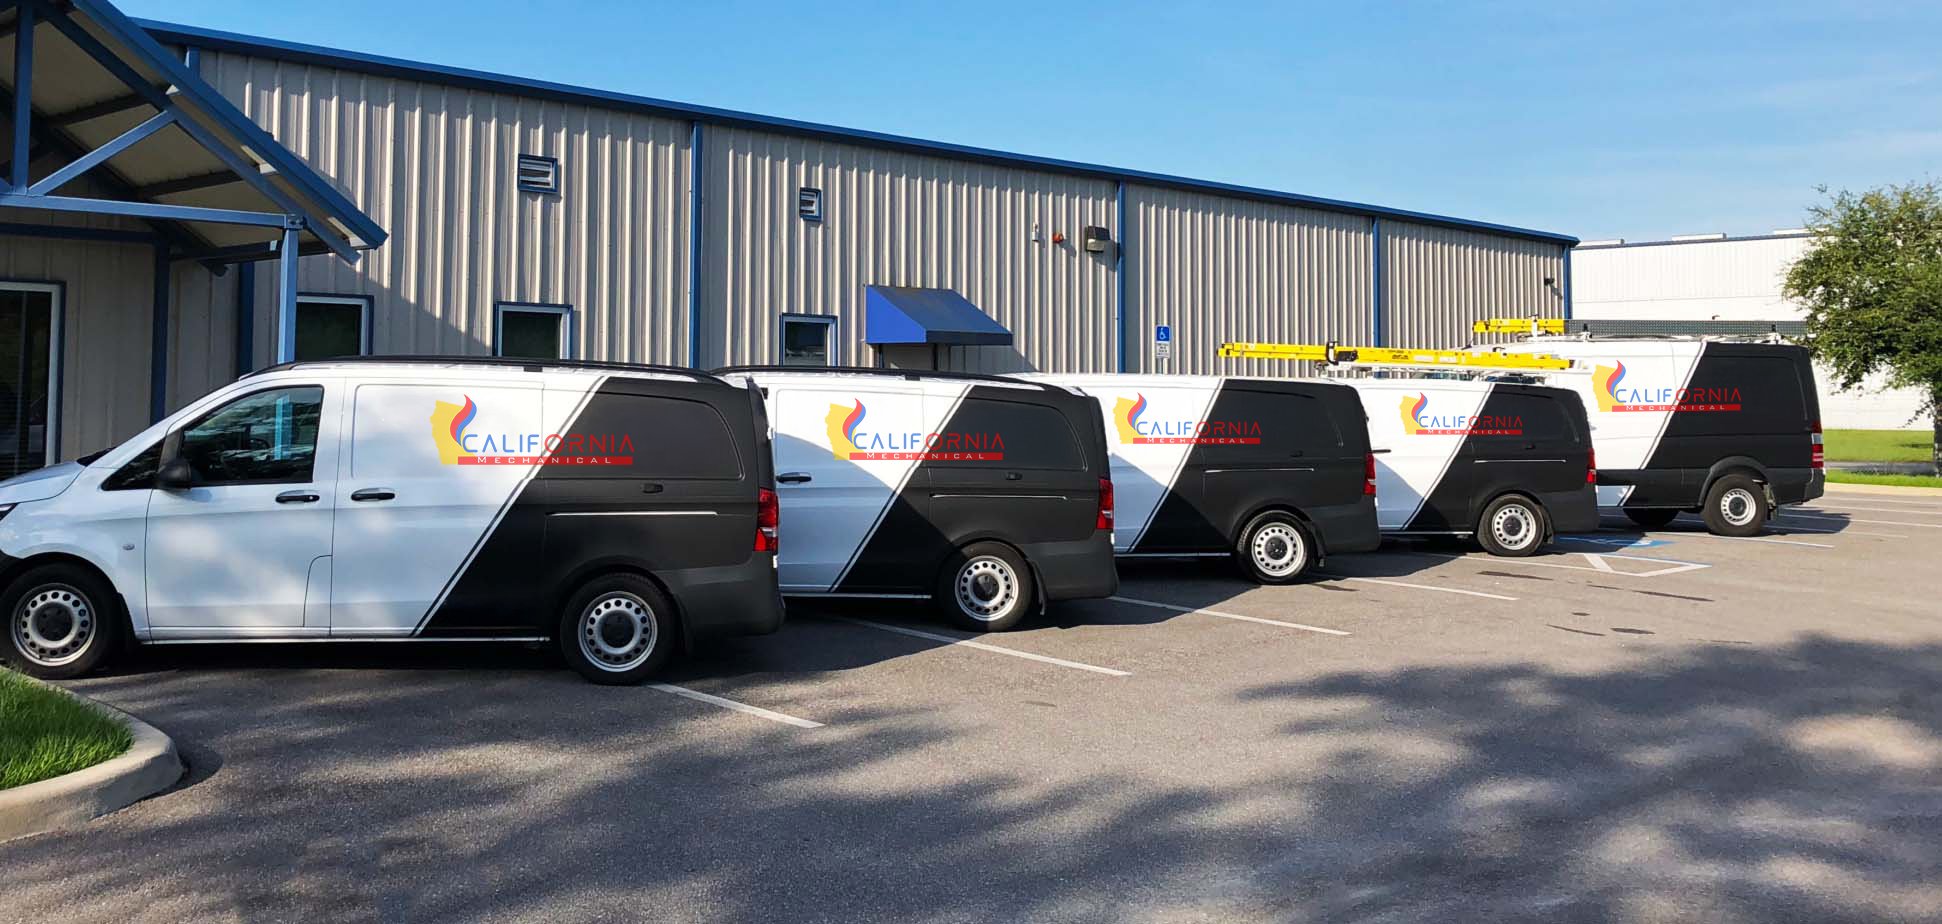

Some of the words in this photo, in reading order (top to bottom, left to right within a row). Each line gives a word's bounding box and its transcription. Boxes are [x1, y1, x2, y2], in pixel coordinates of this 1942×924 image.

[1615, 387, 1742, 403] CALIFORNIA
[1136, 421, 1262, 436] CALIFORNIA
[1419, 416, 1523, 428] CALIFORNIA
[462, 433, 635, 453] CALIFORNIA
[853, 432, 1005, 451] CALIFORNIA
[477, 456, 611, 464] MECHANICAL
[866, 452, 984, 460] MECHANICAL
